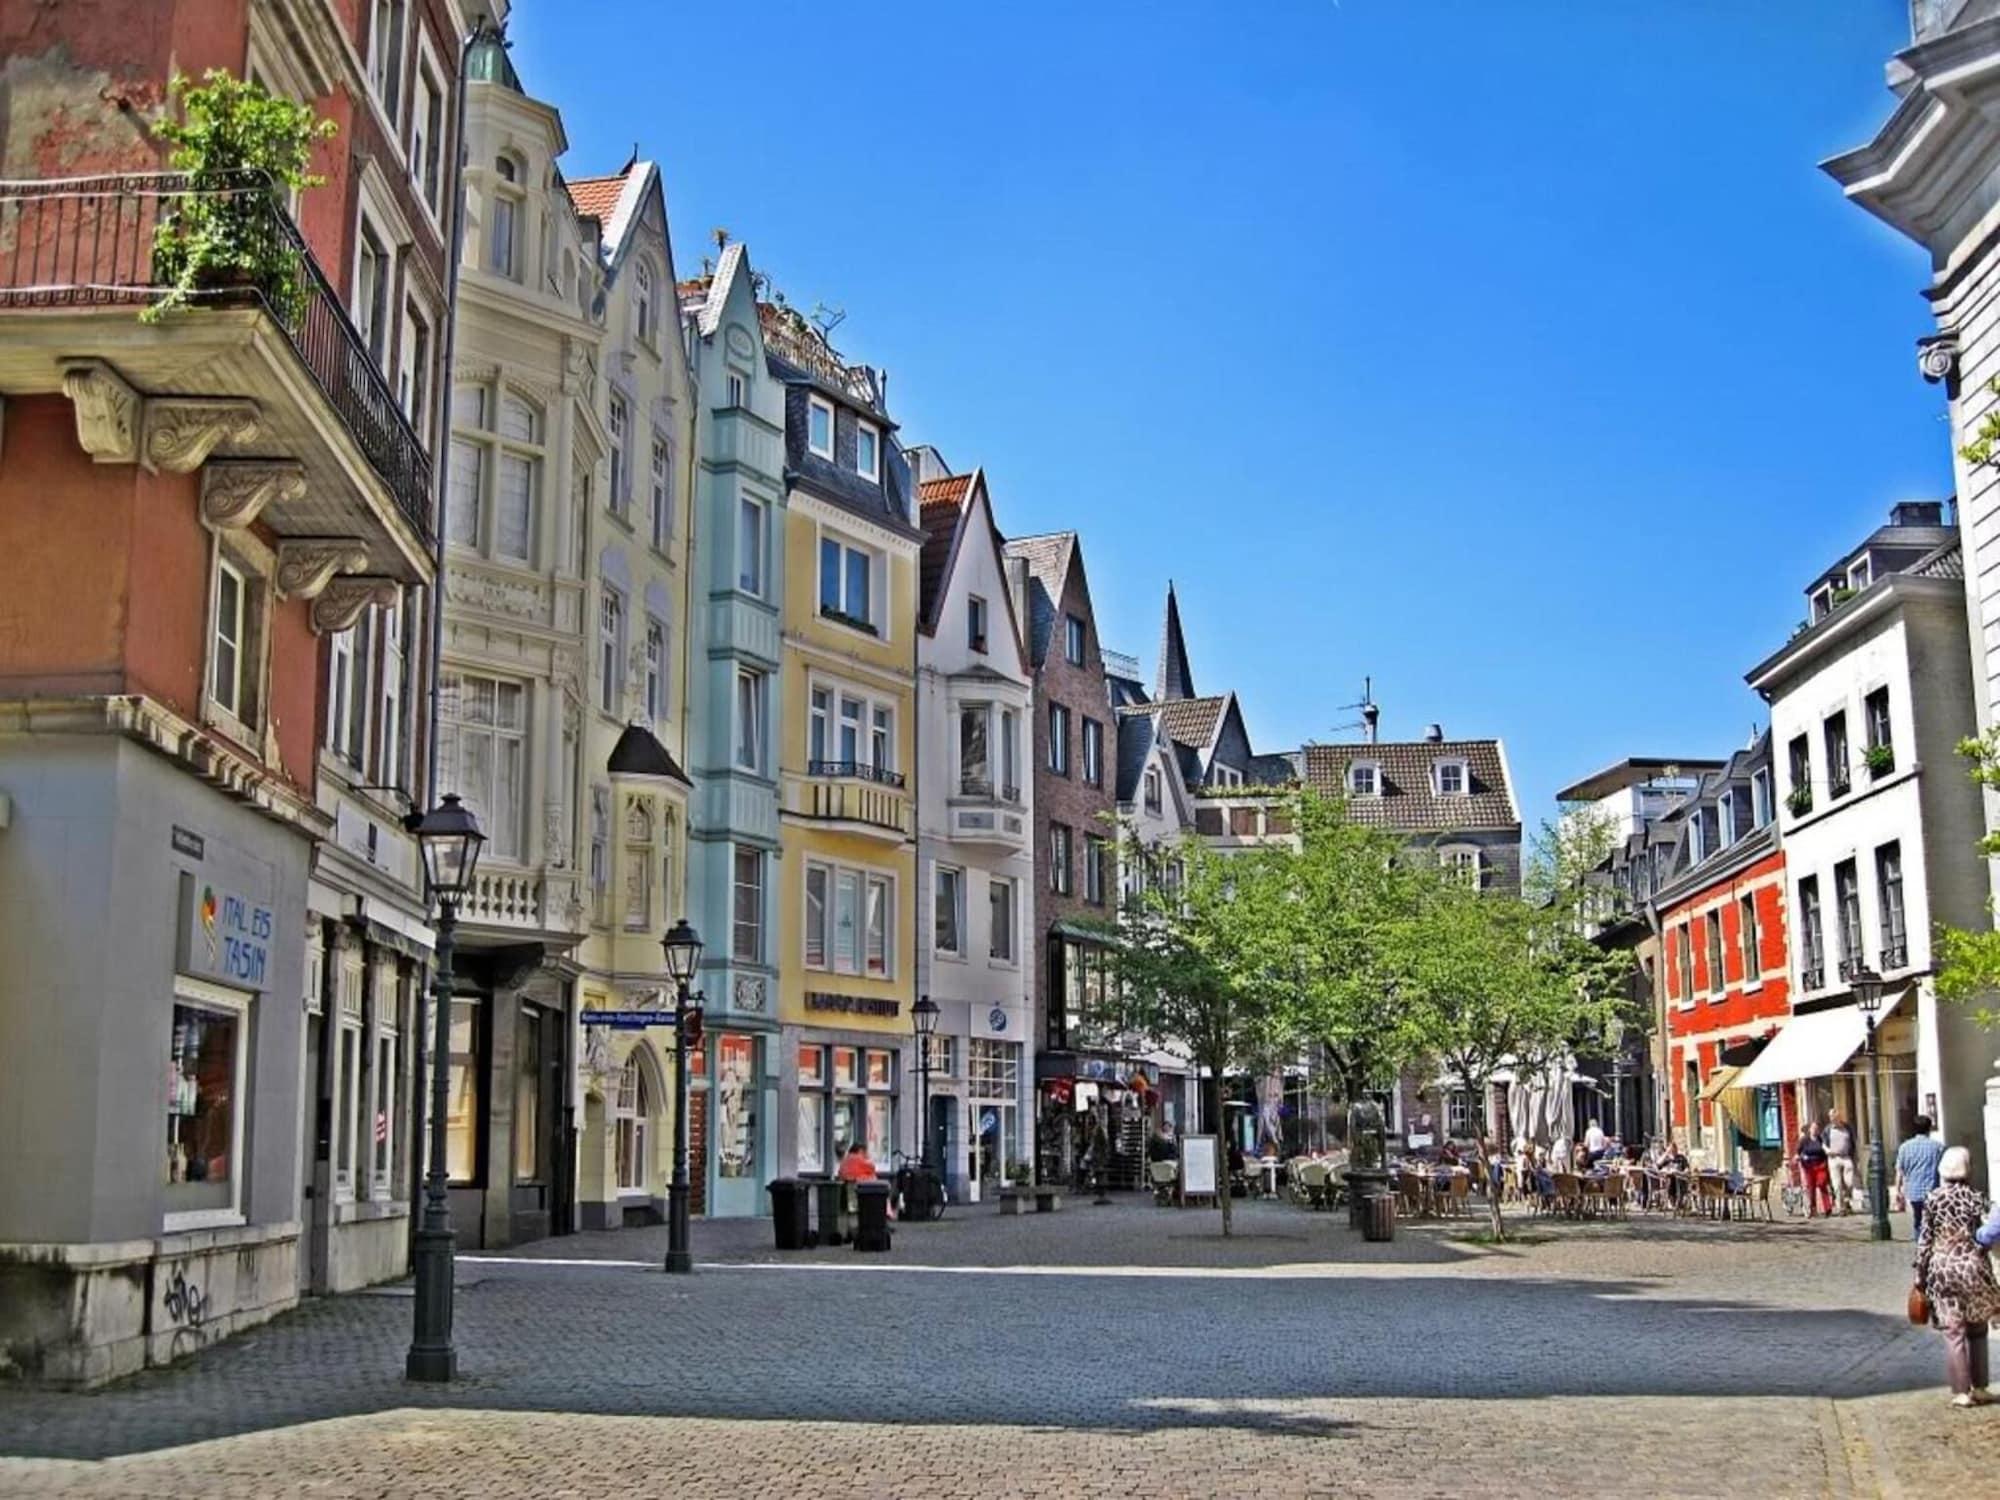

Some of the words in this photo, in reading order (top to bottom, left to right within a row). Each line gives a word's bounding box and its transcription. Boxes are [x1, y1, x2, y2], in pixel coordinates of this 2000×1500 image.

[222, 895, 248, 932] ITAL
[251, 907, 272, 940] EIS
[223, 936, 267, 985] TASIN
